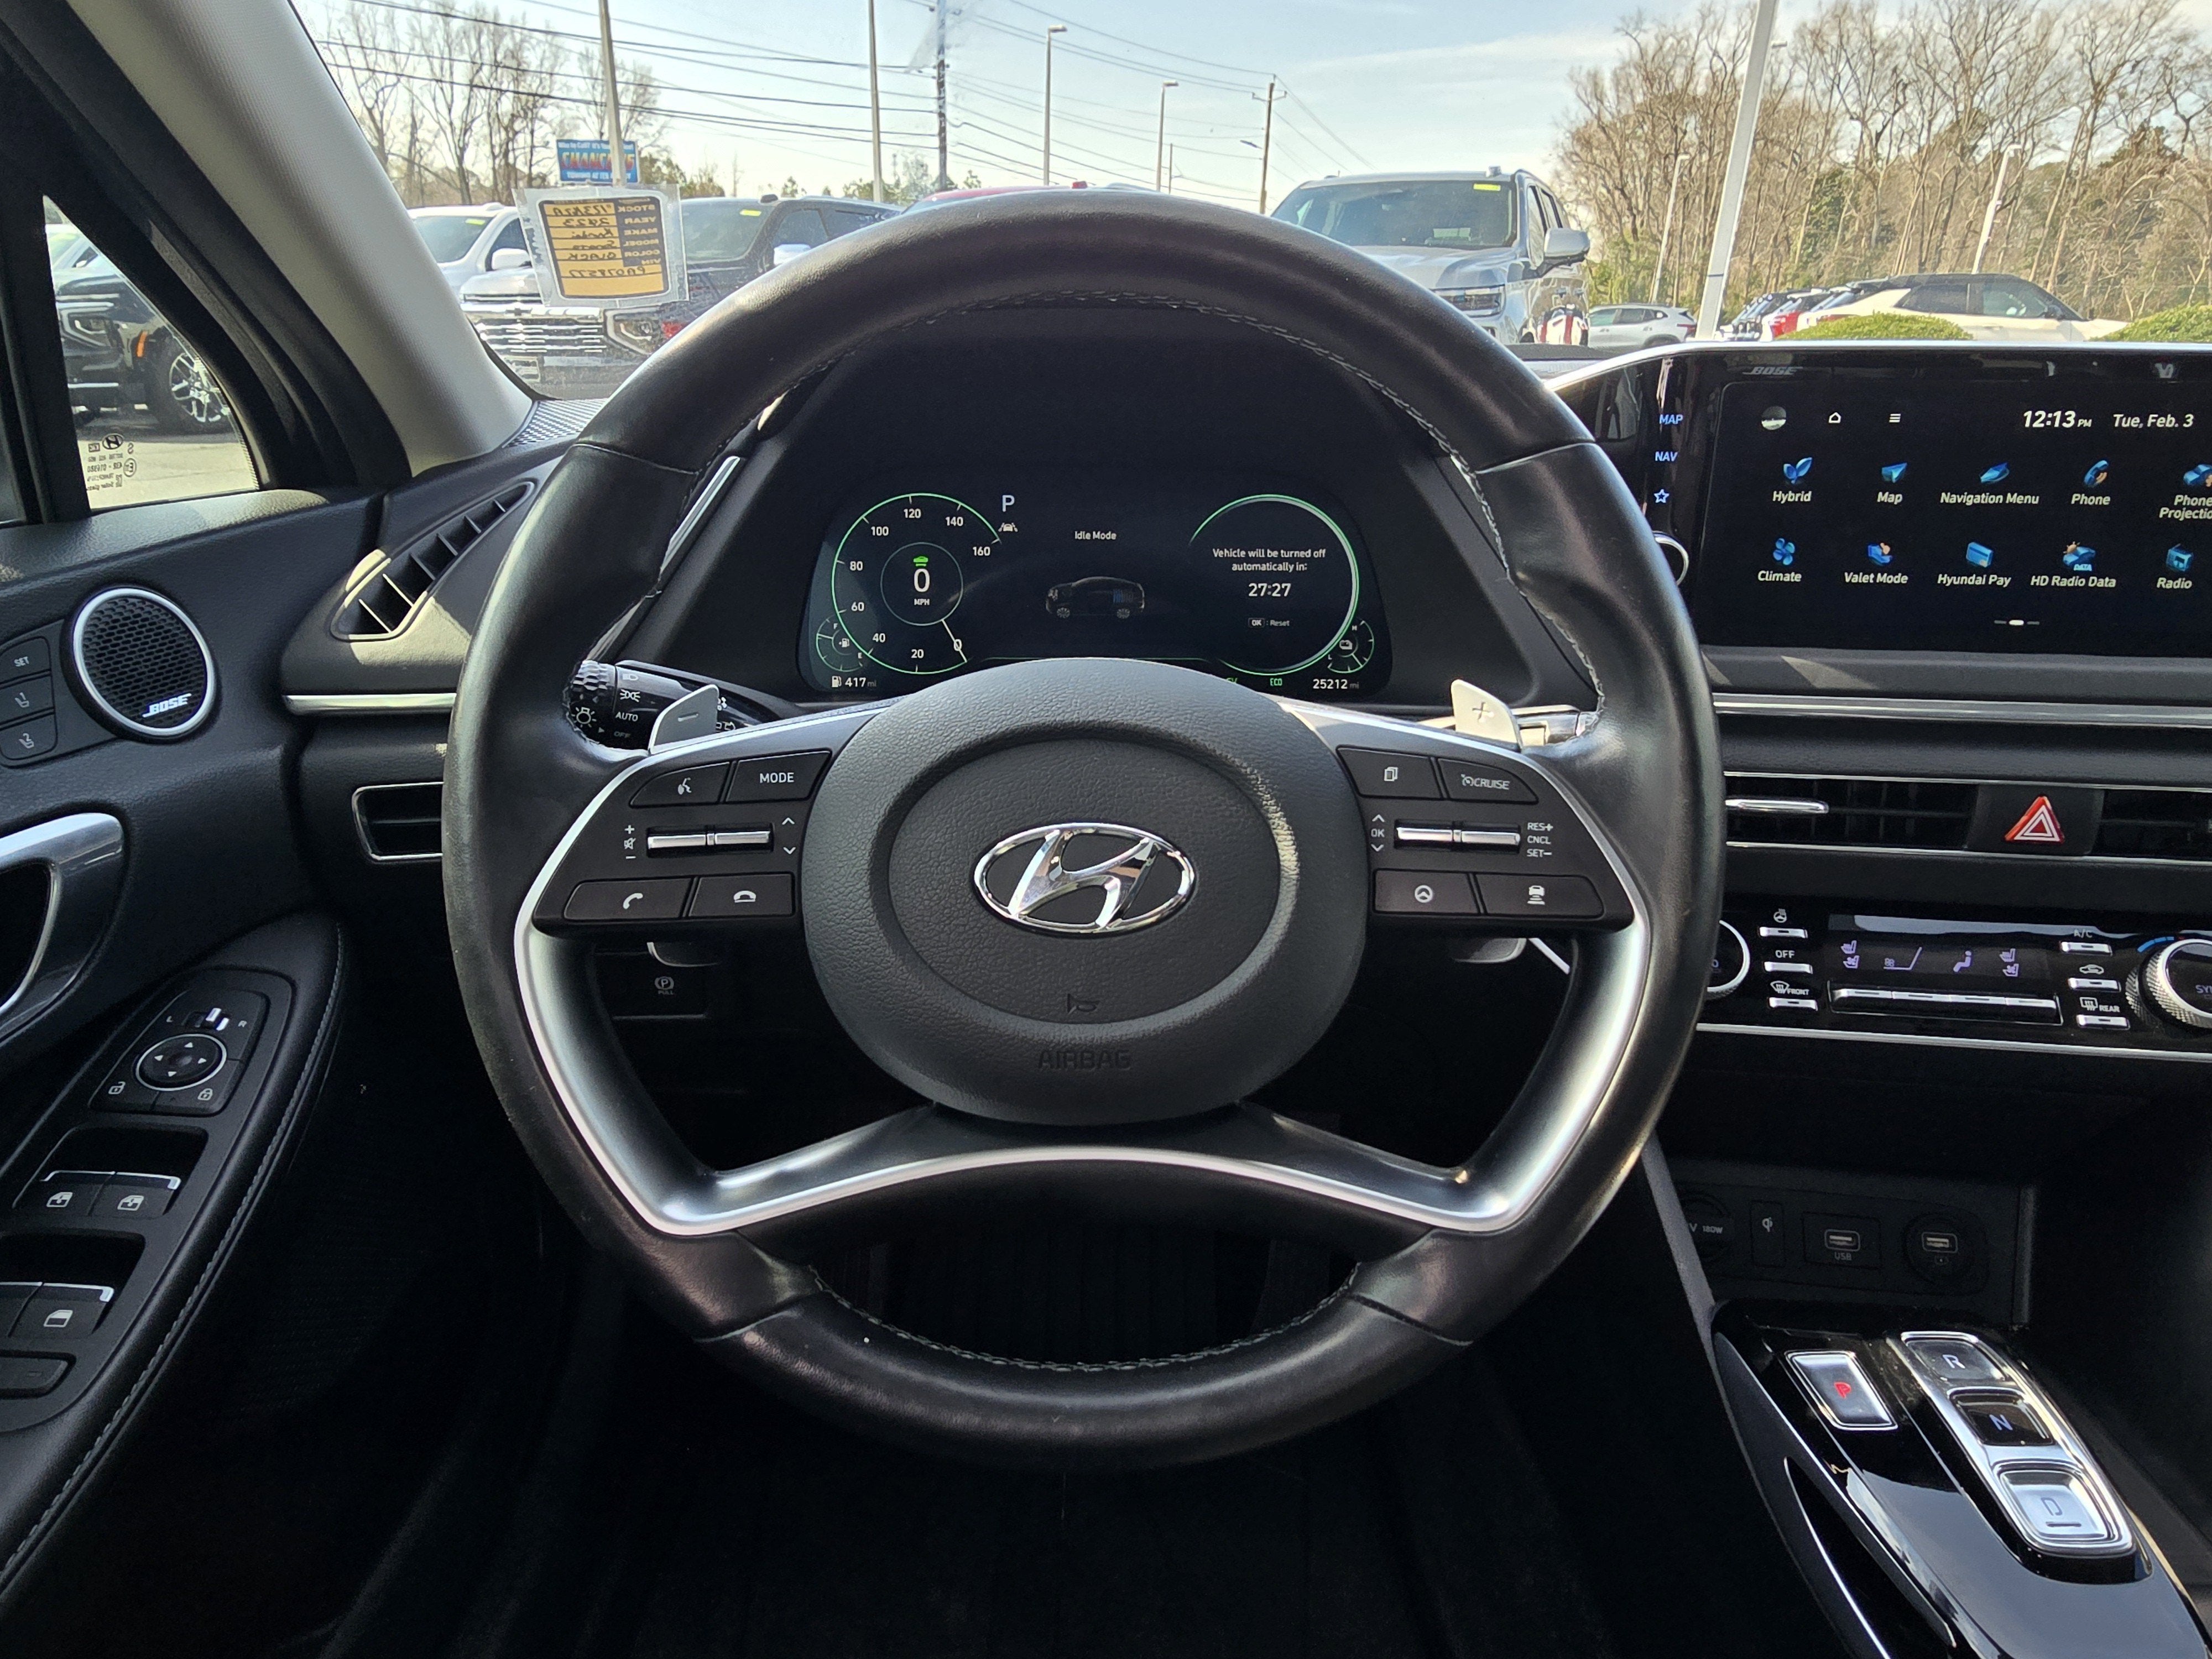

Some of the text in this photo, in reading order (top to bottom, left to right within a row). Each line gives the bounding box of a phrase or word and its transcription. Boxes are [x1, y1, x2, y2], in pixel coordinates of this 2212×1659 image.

[1659, 414, 1683, 425] MAP
[2023, 410, 2194, 429] 12:13 PM Tue, Feb. 3
[1655, 451, 1678, 462] NAV
[1002, 494, 1015, 512] P
[1772, 491, 1812, 504] Hybrid
[1877, 491, 1903, 505] Map
[1940, 492, 2039, 506] Navigation Menu
[2071, 493, 2111, 505] Phone
[2173, 494, 2212, 507] Phone
[904, 508, 921, 519] 120
[945, 516, 964, 526] 140
[870, 526, 889, 536] 100
[1074, 531, 1117, 540] Idle Mode
[972, 546, 990, 556] 160
[1212, 548, 1326, 558] Vehicle will be turned off
[849, 561, 863, 571] 80
[1232, 561, 1307, 573] automatically in:
[914, 568, 930, 592] 0
[1757, 570, 1802, 582] Climate
[1844, 572, 1908, 584] Valet Mode
[1937, 573, 2012, 588] Hyundai Pay
[2030, 575, 2116, 587] HD Radio Data
[2156, 577, 2192, 589] Radio
[1248, 582, 1291, 597] 27:27
[851, 602, 864, 612] 60
[872, 633, 886, 643] 40
[911, 649, 924, 659] 20
[14, 656, 29, 667] SET
[844, 677, 867, 687] 417
[1270, 677, 1282, 686] ECO
[1313, 679, 1348, 690] 25212
[142, 693, 192, 718] BOSE
[615, 711, 638, 722] AUTO
[759, 772, 794, 783] MODE
[1473, 778, 1510, 790] CRUISE
[1371, 828, 1385, 838] OK
[1527, 835, 1551, 844] CNCL
[2074, 929, 2093, 938] A/C
[1775, 950, 1795, 958] OFF
[1787, 987, 1809, 995] FRONT
[2099, 1004, 2120, 1013] REAR
[1039, 1050, 1131, 1070] AIRBAG
[1834, 1251, 1852, 1261] USB
[1942, 1354, 1965, 1369] R
[1834, 1381, 1851, 1400] P
[1989, 1414, 2013, 1431] N
[2041, 1497, 2063, 1516] D
